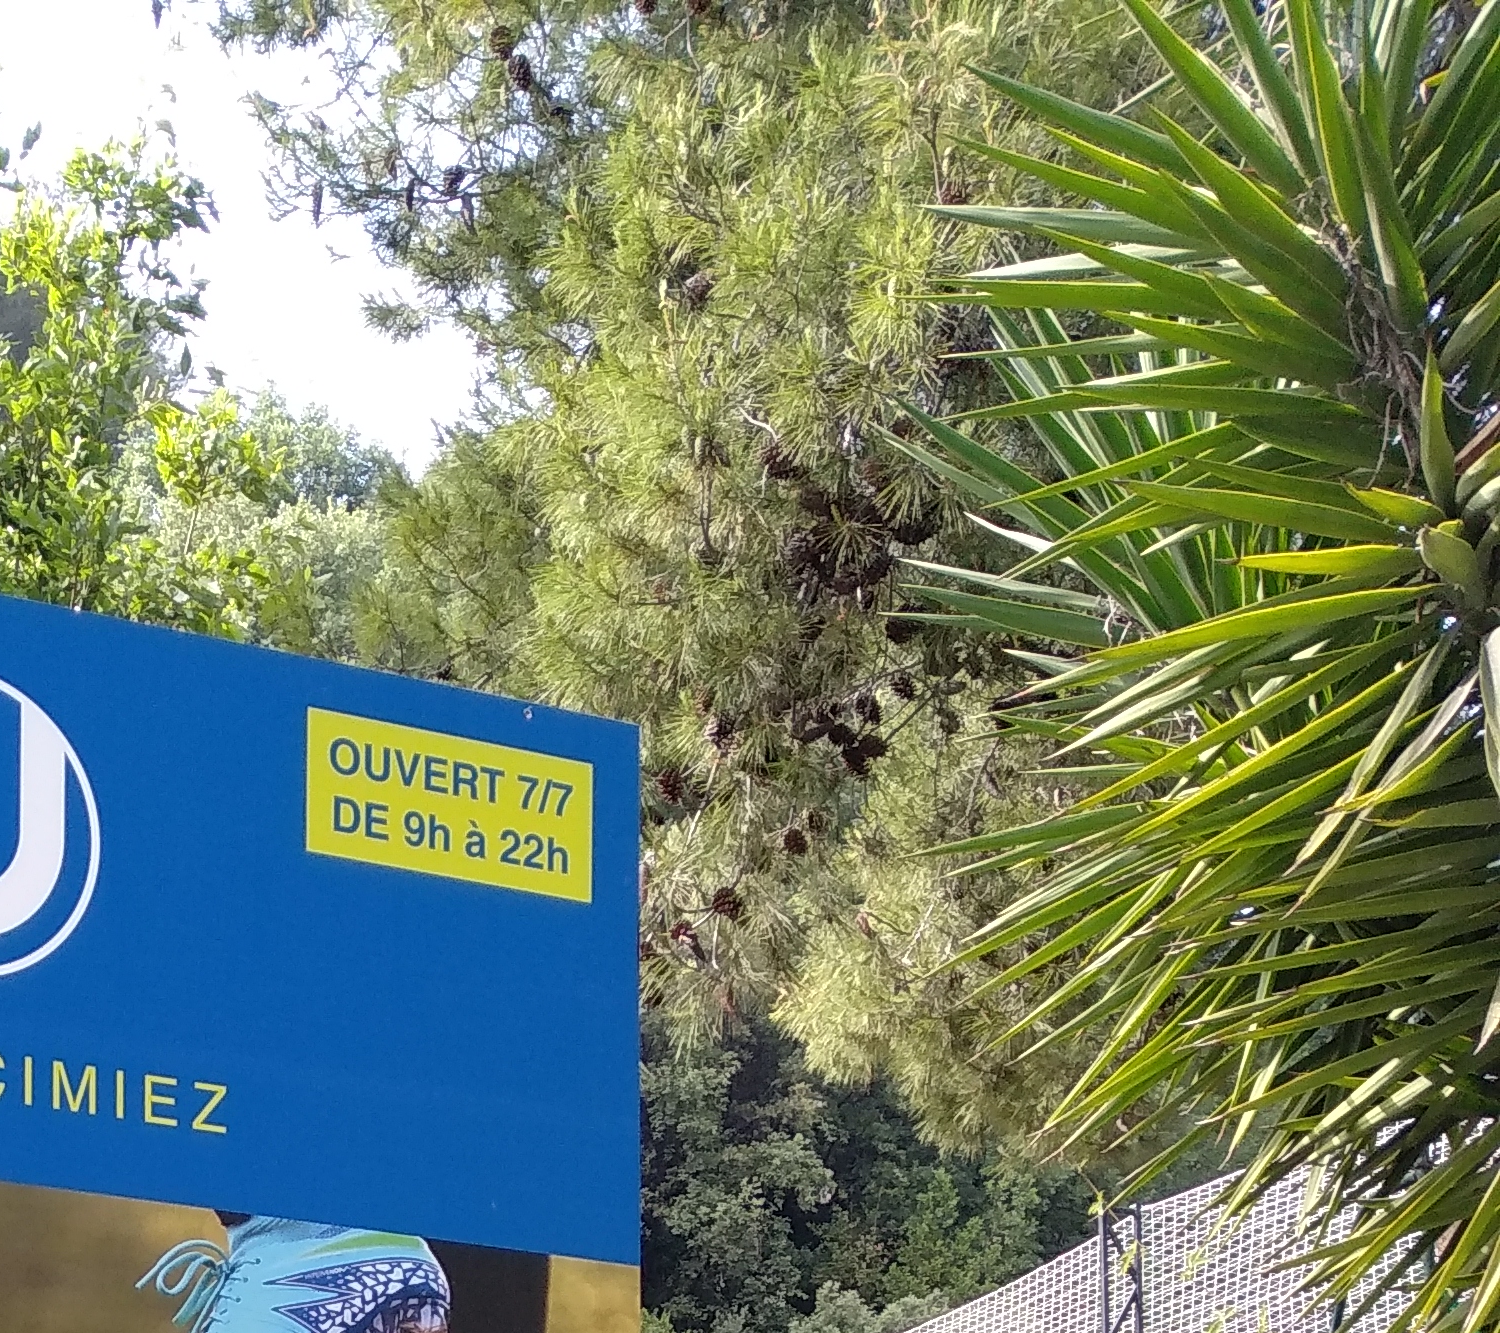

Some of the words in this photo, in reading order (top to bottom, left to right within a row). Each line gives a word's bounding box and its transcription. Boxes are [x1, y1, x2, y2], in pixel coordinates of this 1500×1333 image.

[328, 738, 506, 805] OUVERT
[517, 774, 574, 818] 7/7
[332, 796, 390, 842] DE
[403, 811, 451, 852] 9h
[464, 817, 486, 859] à
[498, 829, 569, 875] 22h
